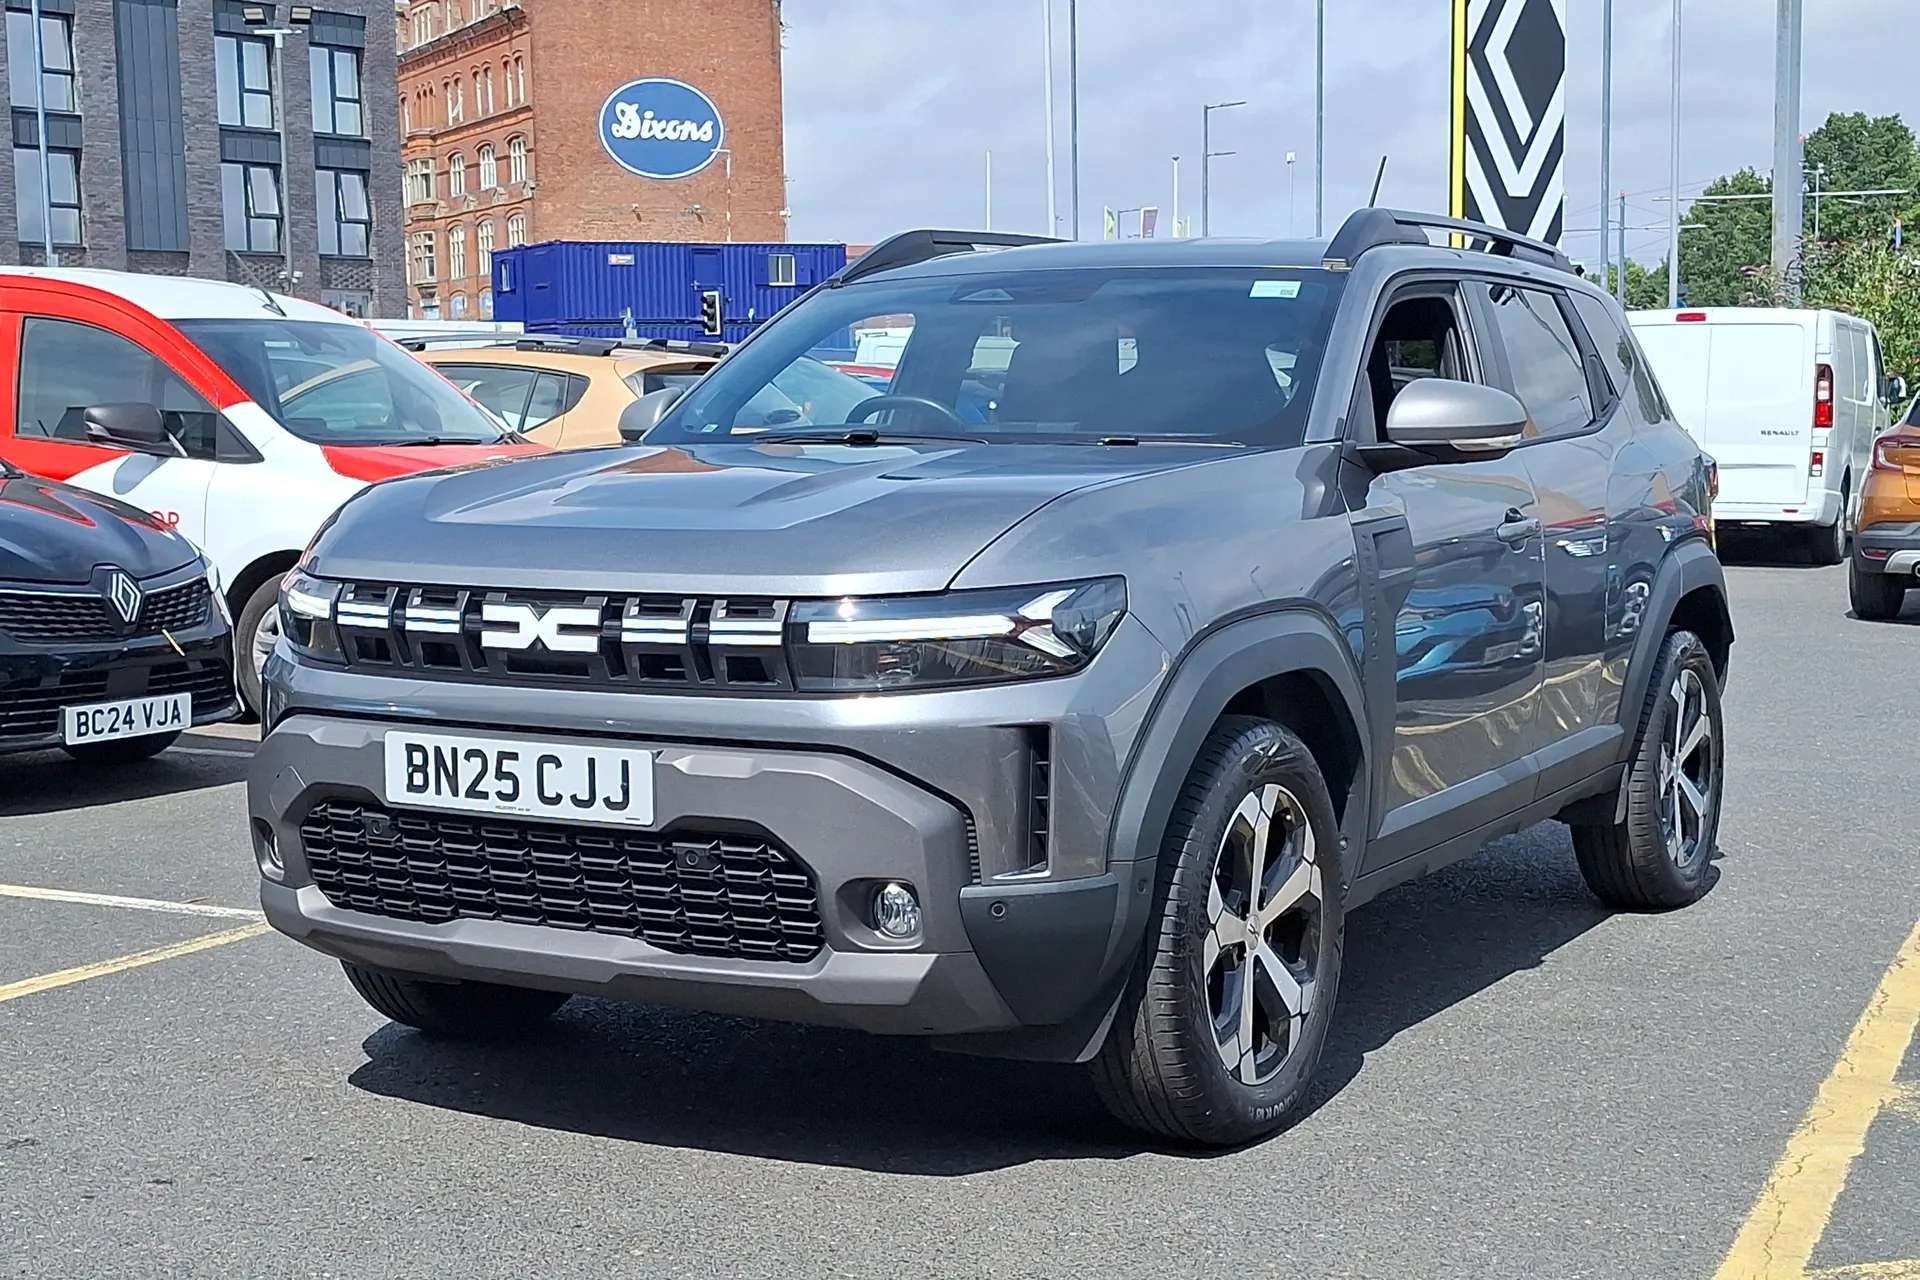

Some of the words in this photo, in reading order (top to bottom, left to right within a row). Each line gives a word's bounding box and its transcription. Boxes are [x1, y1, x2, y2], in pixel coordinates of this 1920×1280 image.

[611, 101, 714, 142] Dixons
[76, 705, 135, 738] BC24
[142, 699, 181, 729] VJA
[405, 743, 520, 803] BN25
[536, 754, 630, 811] CJJ
